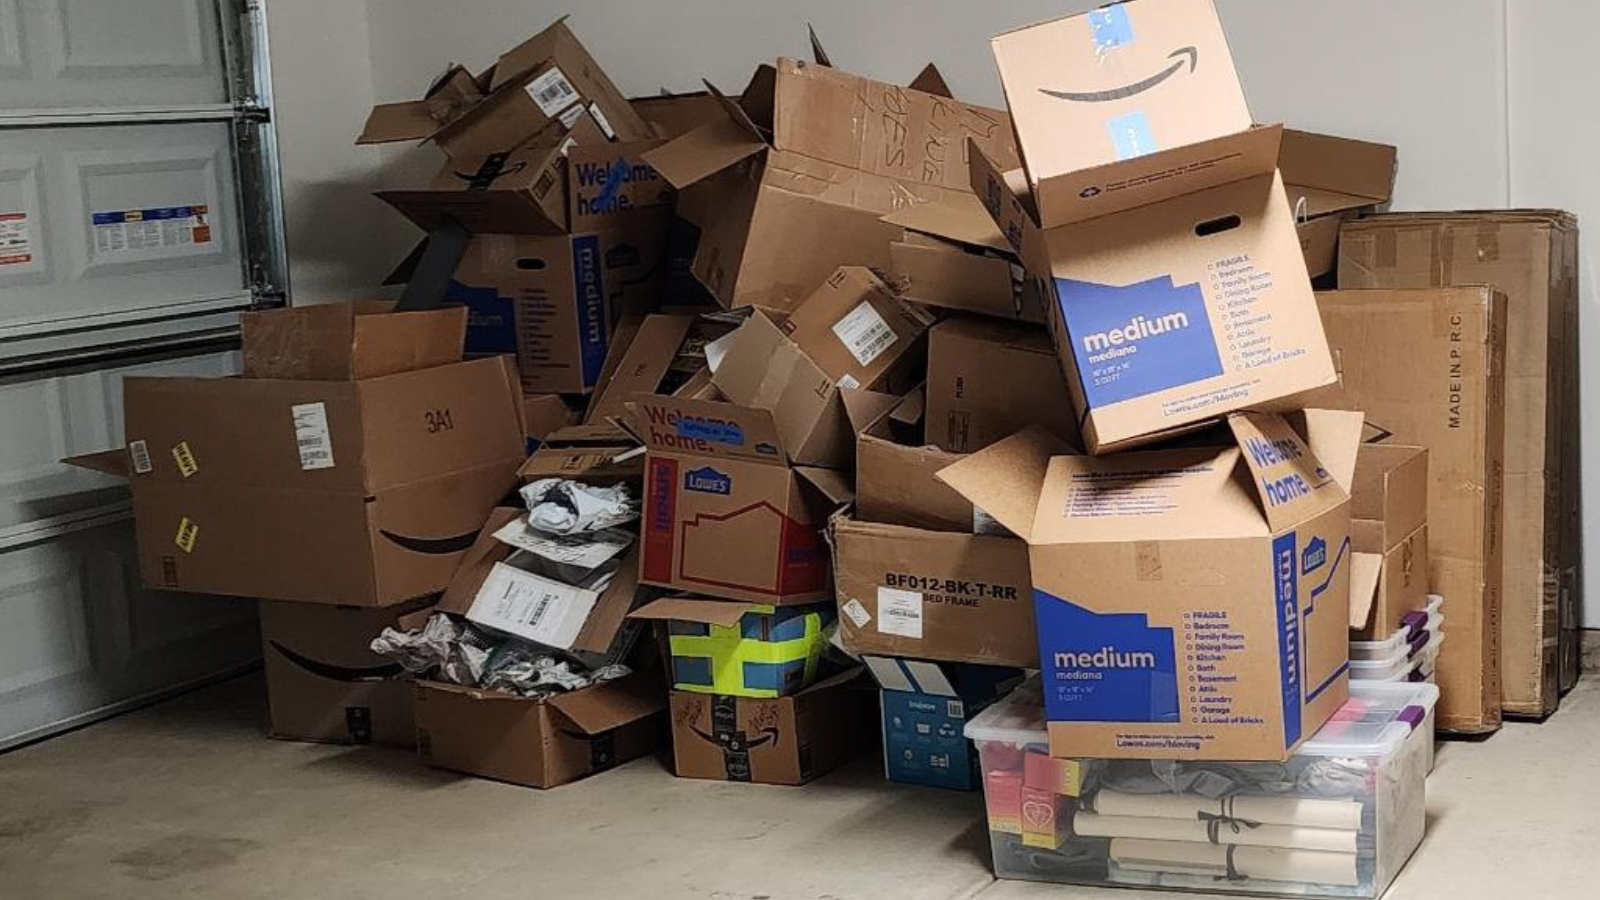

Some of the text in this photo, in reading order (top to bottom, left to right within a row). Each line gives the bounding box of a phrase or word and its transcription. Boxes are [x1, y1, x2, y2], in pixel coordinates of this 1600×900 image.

[576, 161, 658, 186] Welome
[582, 246, 602, 343] medium
[1083, 312, 1189, 352] medium
[1449, 364, 1461, 378] IN
[1449, 382, 1461, 428] MADE
[425, 409, 454, 434] 3A1
[885, 573, 1017, 600] BF012-BK-T-RR
[945, 594, 980, 607] FRAME
[1282, 549, 1297, 684] medium
[1193, 622, 1229, 630] Bedroom
[1195, 633, 1220, 641] Family
[1195, 643, 1221, 652] Dining
[1054, 646, 1155, 668] medium
[1056, 671, 1102, 680] mediana
[1199, 695, 1232, 703] Laundry
[1200, 706, 1230, 714] Garage
[1116, 738, 1200, 750] Lowes.com/Moving
